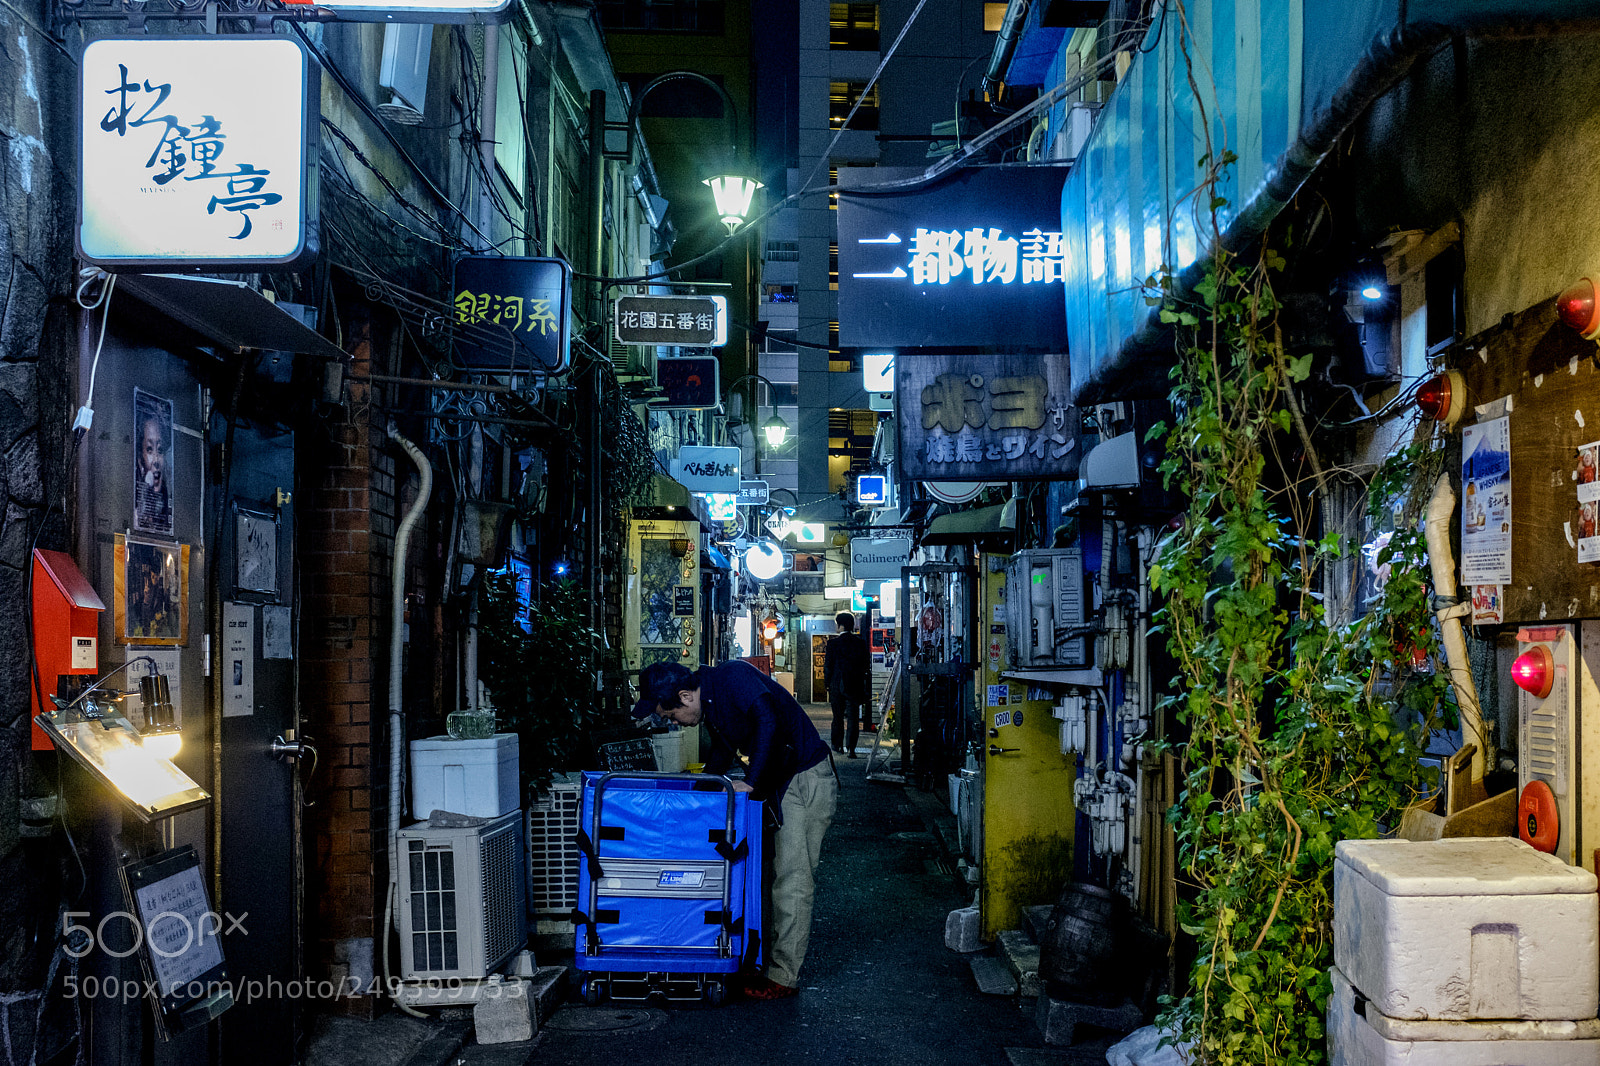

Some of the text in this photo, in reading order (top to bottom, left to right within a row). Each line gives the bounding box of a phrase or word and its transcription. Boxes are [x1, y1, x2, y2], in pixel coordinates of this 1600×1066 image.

[853, 227, 1065, 285] 二都物語
[454, 289, 558, 336] 銀河系
[620, 310, 714, 331] 花園五番街
[1479, 476, 1499, 491] WHISKY
[853, 553, 905, 564] Calimero
